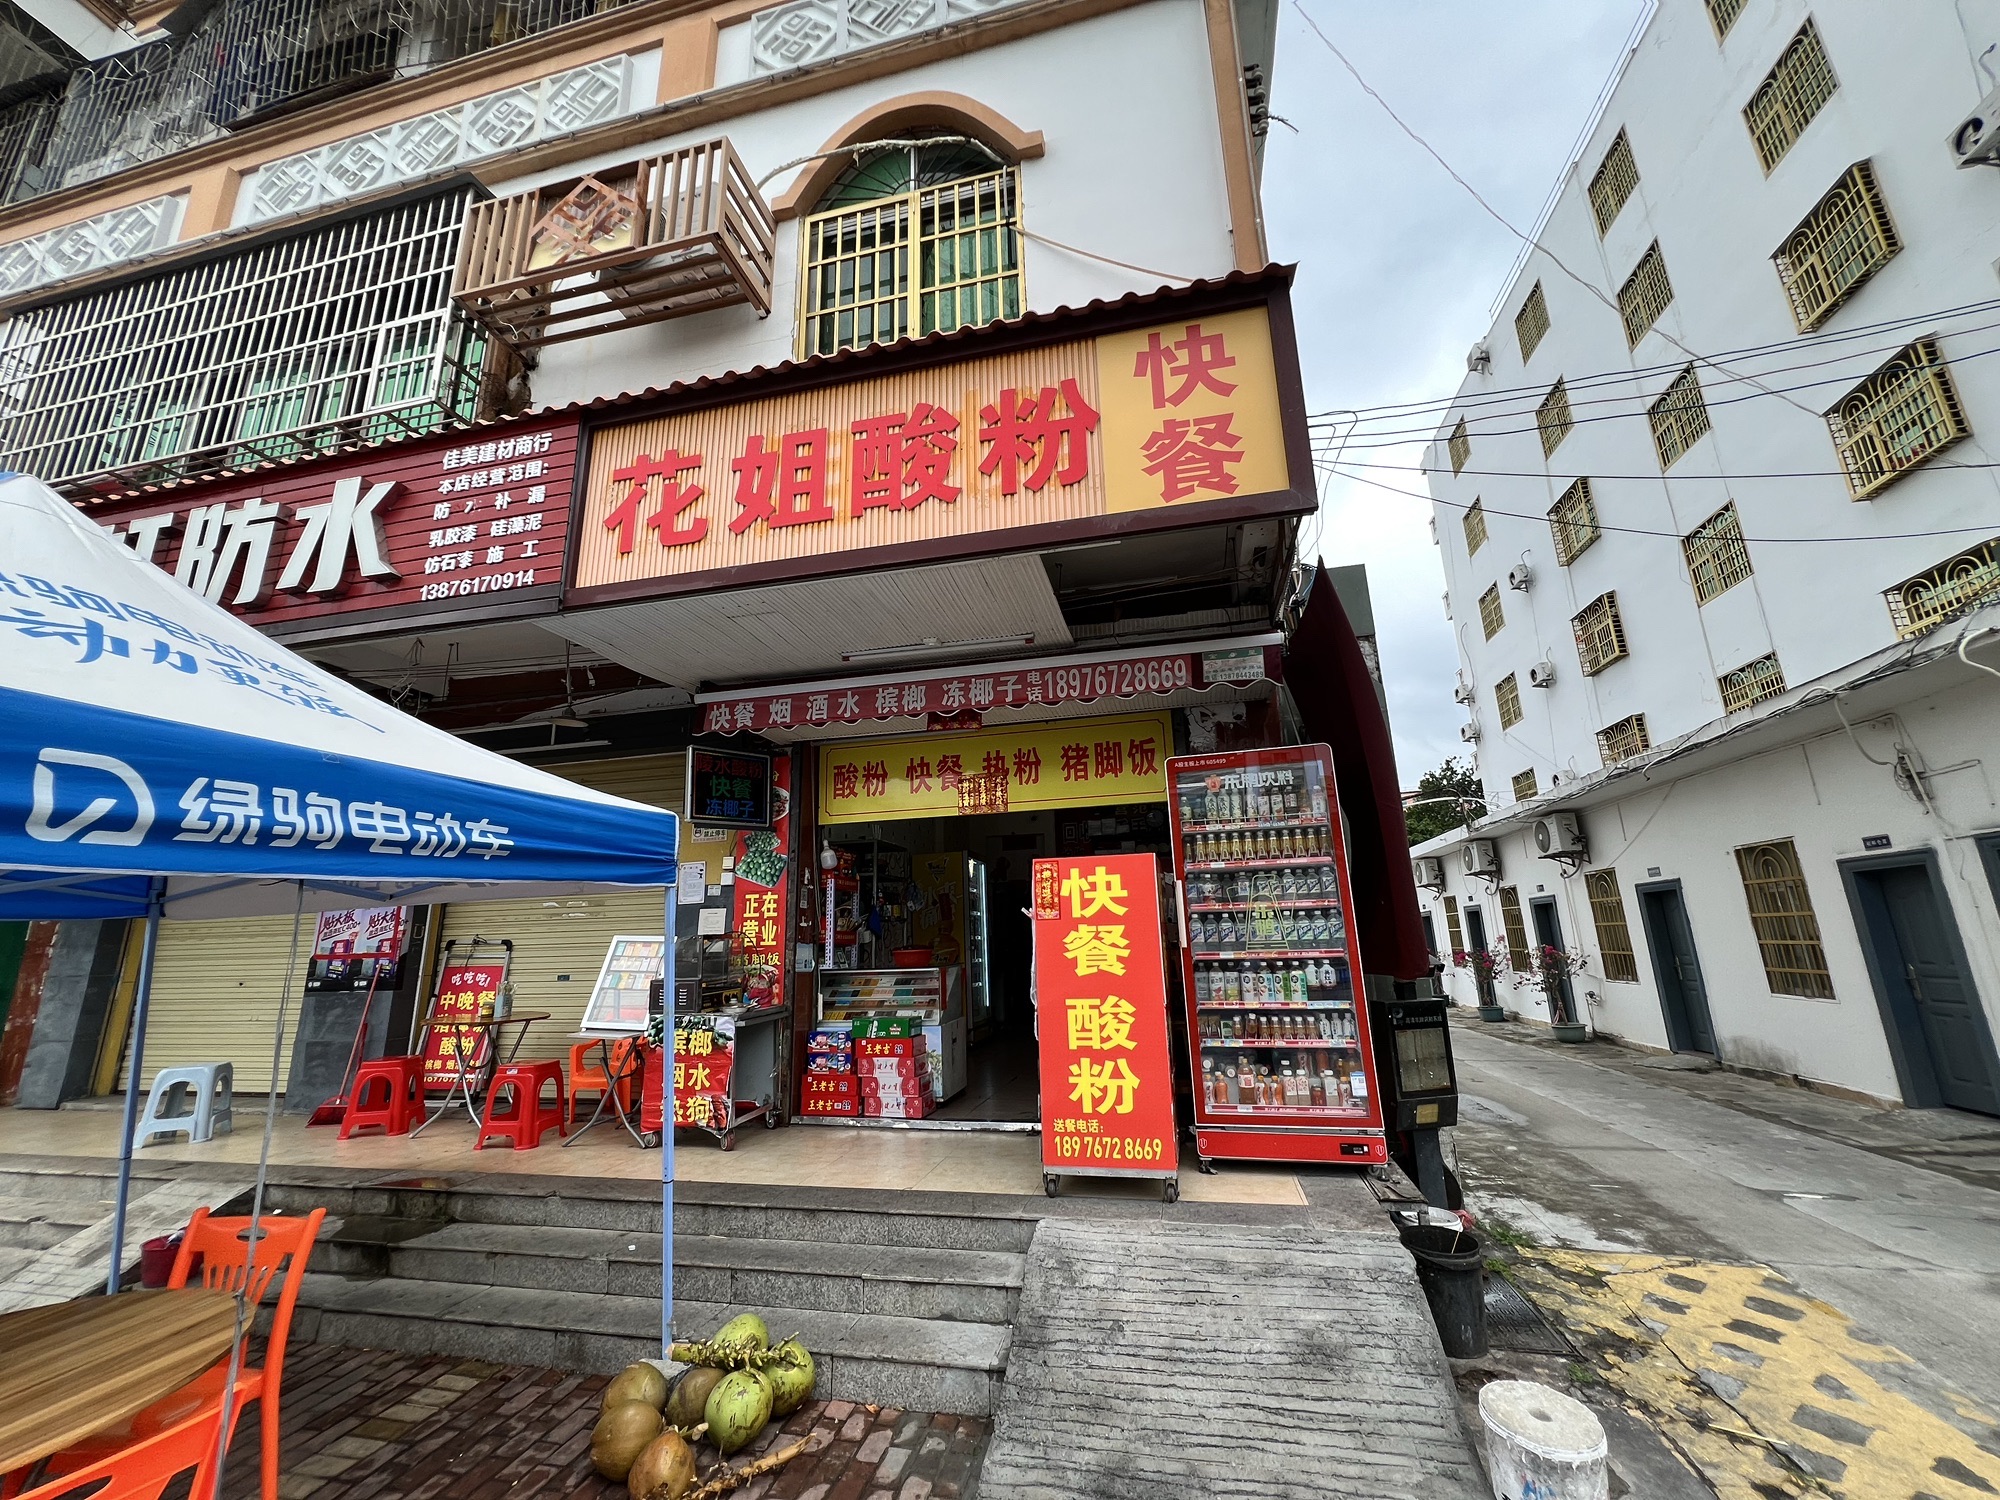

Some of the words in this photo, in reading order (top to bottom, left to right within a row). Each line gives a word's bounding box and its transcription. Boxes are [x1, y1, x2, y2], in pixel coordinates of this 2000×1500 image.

[1134, 324, 1245, 502] 快餐
[442, 433, 552, 470] 佳美建材商行
[603, 378, 1100, 554] 花姐酸粉
[102, 475, 402, 605] 防水
[429, 525, 478, 548] 乳胶漆
[490, 513, 543, 537] 硅藻泥
[419, 568, 535, 601] 13876170914
[0, 572, 328, 692] 驹电动车
[708, 701, 756, 731] 快餐
[875, 685, 926, 714] 槟榔
[941, 674, 1022, 708] 冻椰子
[1044, 658, 1187, 699] 18976728669
[696, 756, 764, 780] 陵水酸粉
[832, 760, 889, 800] 酸粉
[907, 753, 964, 794] 快餐
[1060, 737, 1159, 782] 猪脚饭
[709, 775, 753, 799] 快餐
[173, 776, 516, 863] 绿驹电动车
[706, 798, 755, 819] 冻椰子
[744, 891, 779, 918] 正在
[1060, 866, 1131, 977] 快餐
[742, 919, 778, 948] 营业
[865, 1043, 891, 1055] 王老吉
[1065, 994, 1141, 1115] 酸粉
[811, 1080, 836, 1092] 王老吉
[808, 1099, 834, 1111] 王老吉
